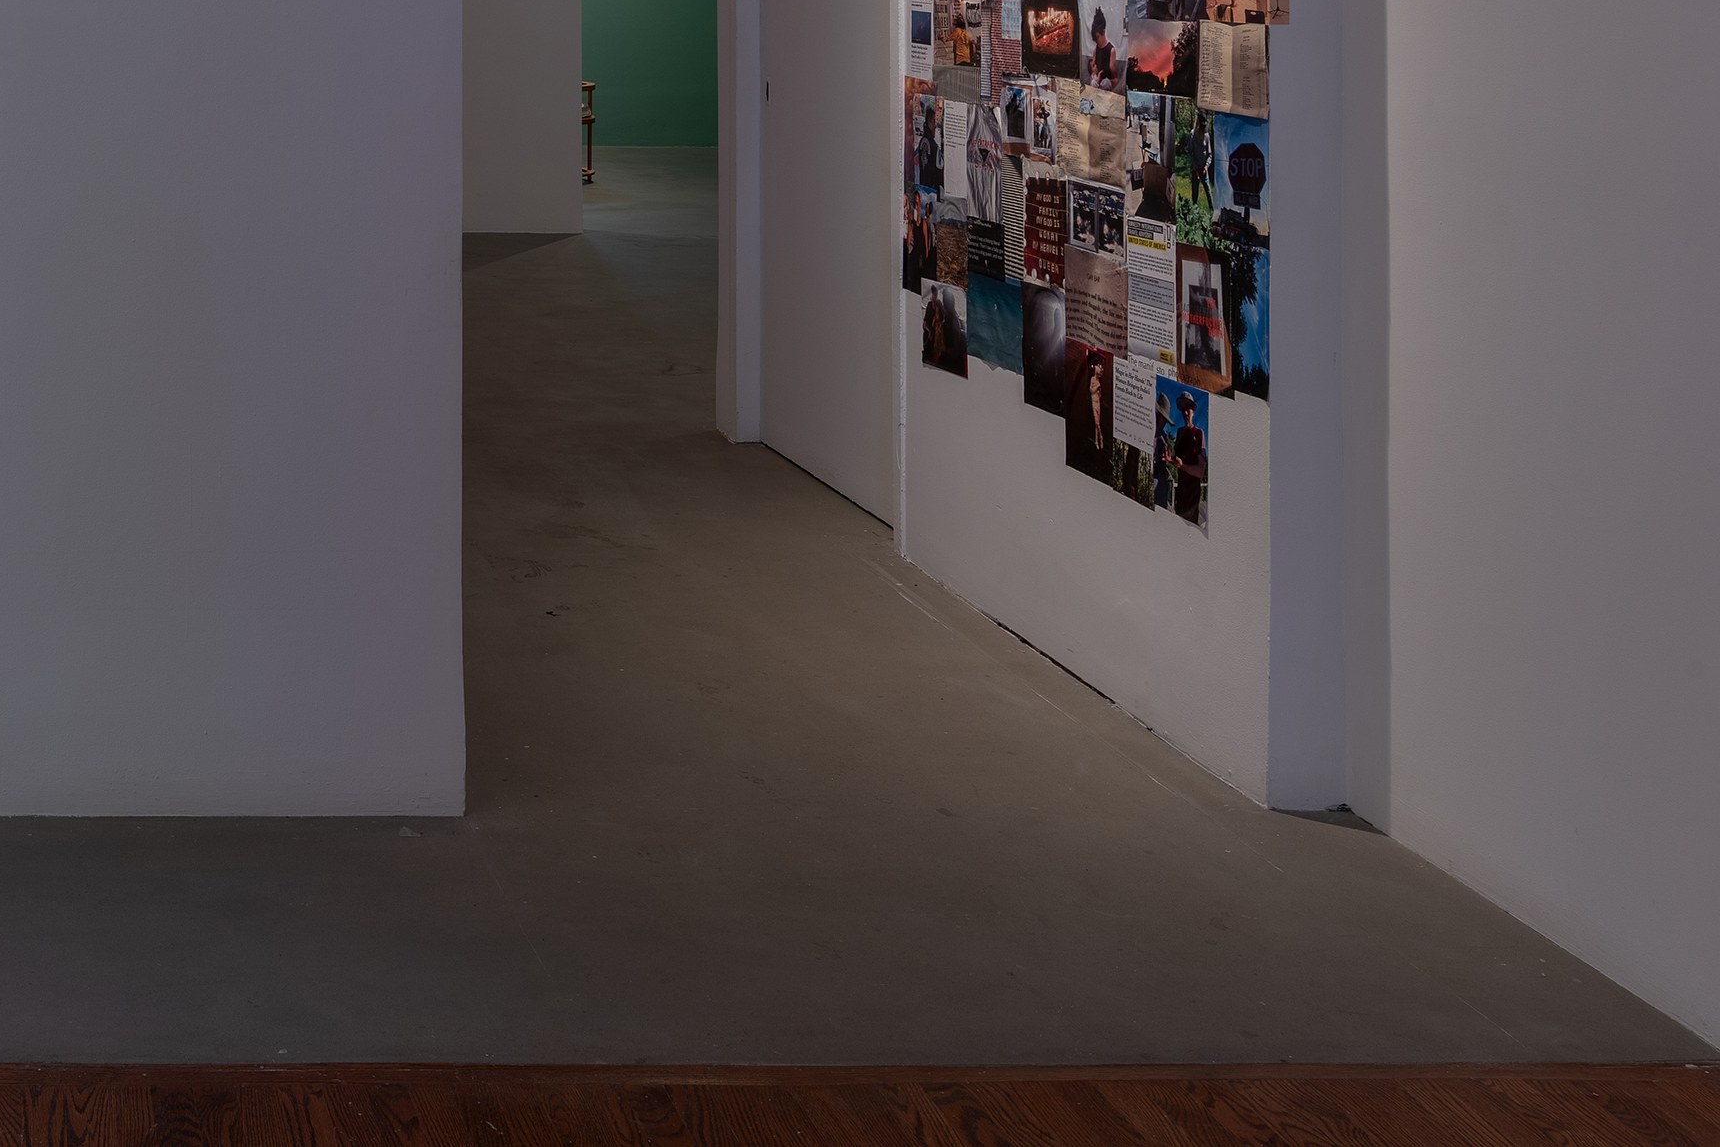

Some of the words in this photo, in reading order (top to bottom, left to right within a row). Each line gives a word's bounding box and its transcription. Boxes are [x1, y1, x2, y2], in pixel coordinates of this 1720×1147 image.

[1230, 158, 1263, 179] STOP
[1043, 194, 1051, 203] GOD
[1053, 196, 1060, 204] IS
[1043, 217, 1052, 227] GOD
[1053, 219, 1060, 228] IS
[1128, 355, 1138, 366] The
